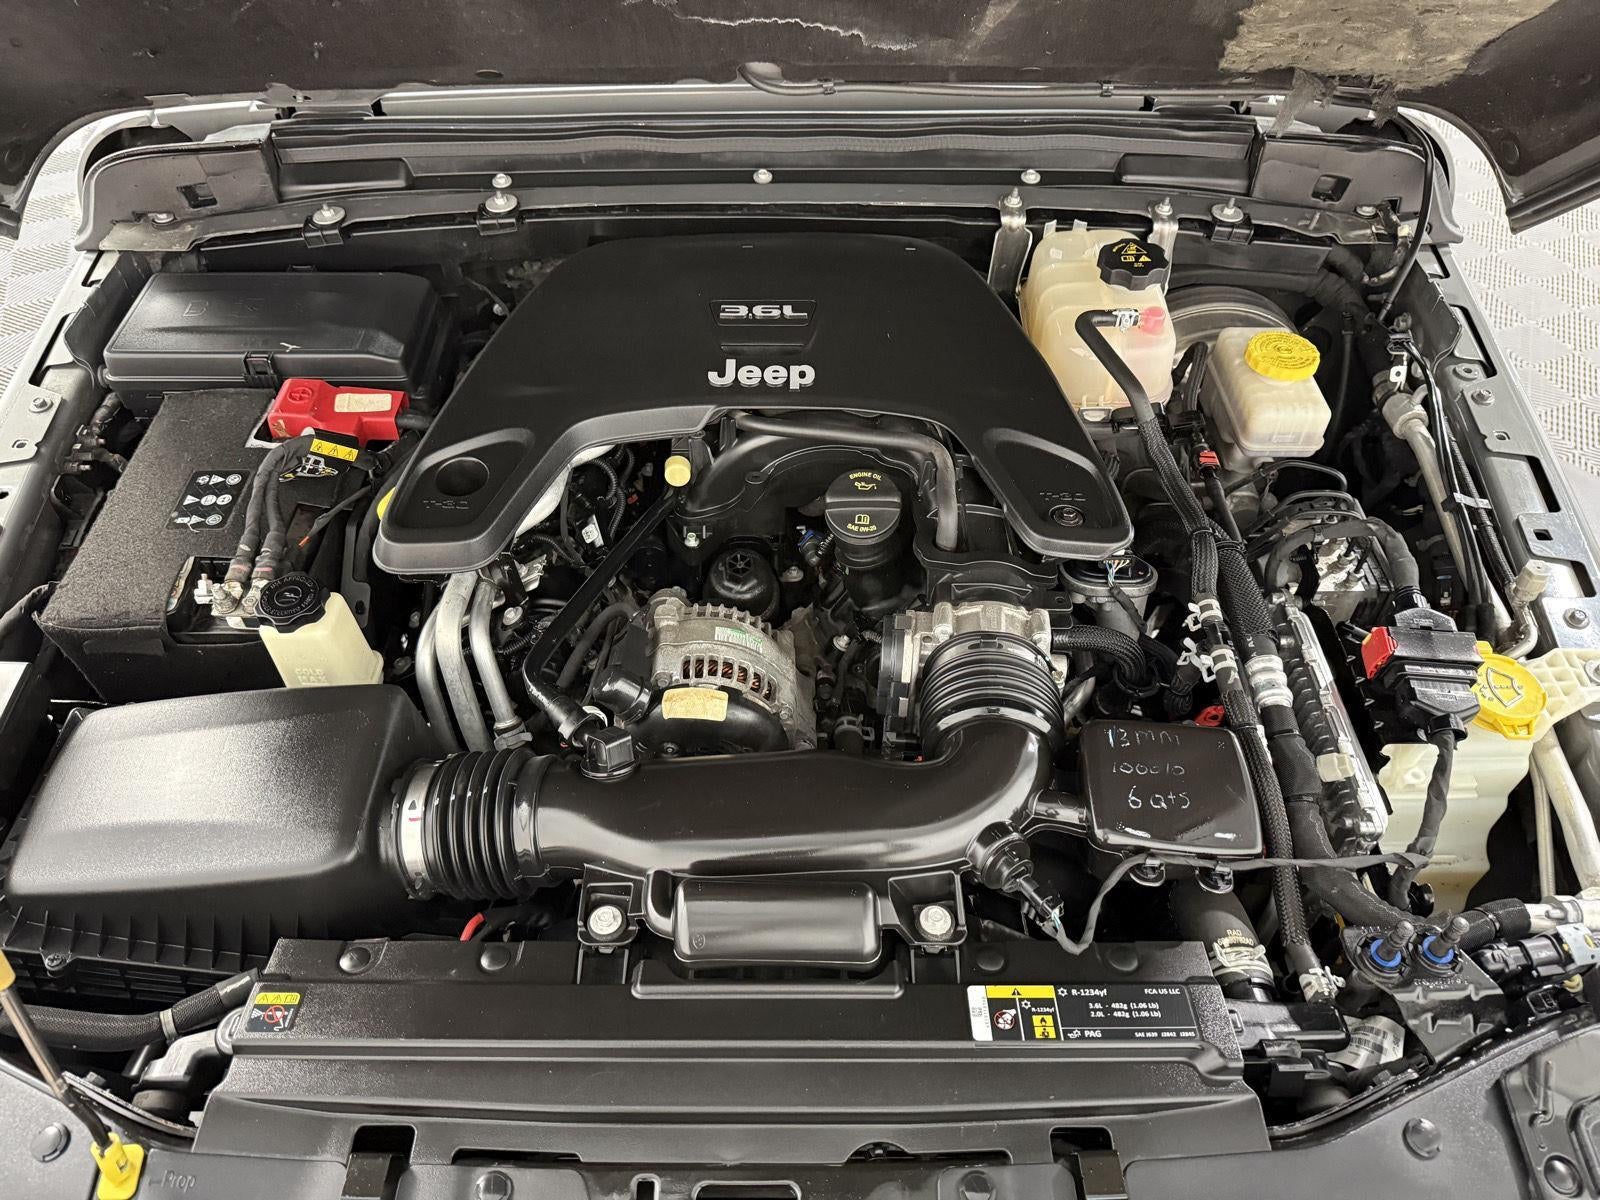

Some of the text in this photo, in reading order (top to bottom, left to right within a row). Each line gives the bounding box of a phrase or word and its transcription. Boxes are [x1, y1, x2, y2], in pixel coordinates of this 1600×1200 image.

[719, 304, 808, 319] 3.6L
[707, 358, 816, 391] Jeep
[849, 472, 881, 481] ENGINE OIL
[847, 523, 858, 532] SAE
[1128, 785, 1142, 809] 6
[1226, 929, 1242, 937] RAD
[1071, 988, 1107, 997] R-1234yf
[1084, 1030, 1102, 1038] PAG
[161, 1169, 196, 1193] Prop
